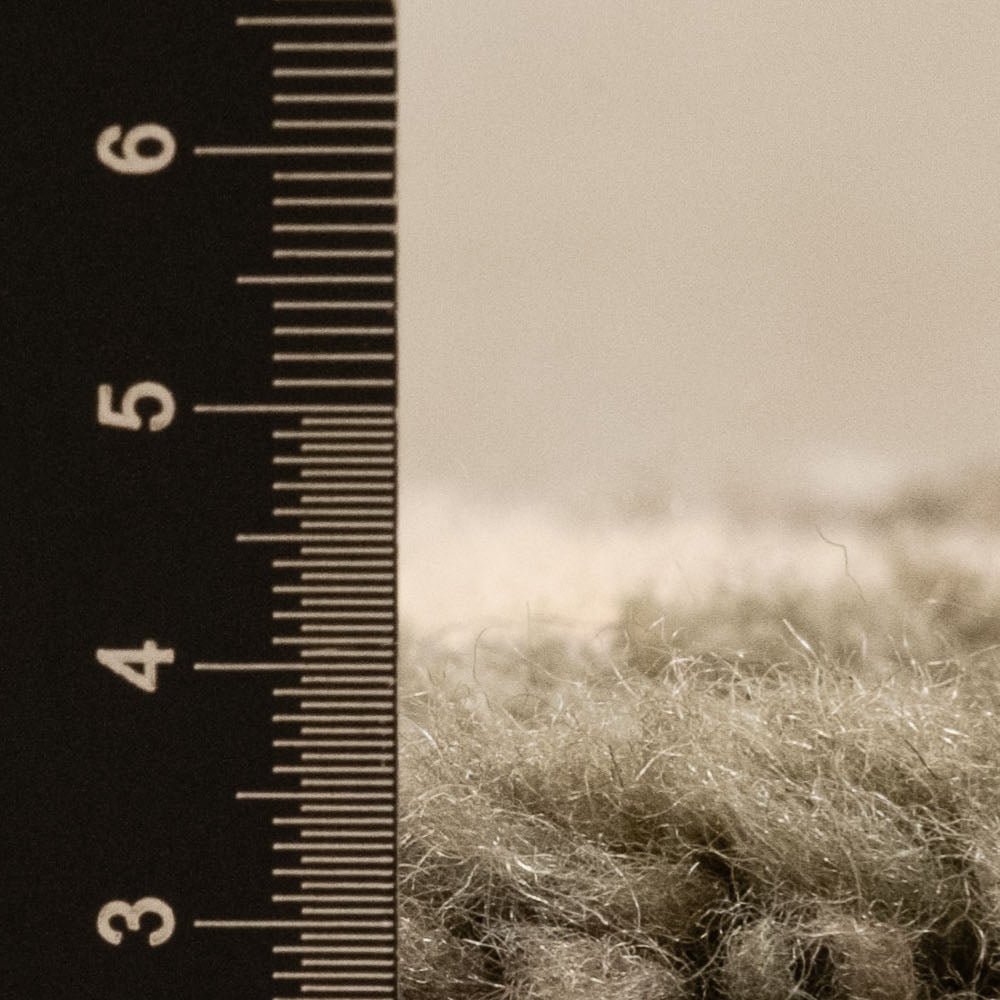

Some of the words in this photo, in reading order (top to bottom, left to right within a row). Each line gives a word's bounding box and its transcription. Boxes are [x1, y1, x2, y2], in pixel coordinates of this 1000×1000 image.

[96, 123, 176, 174] 6
[97, 381, 176, 432] 5
[96, 639, 175, 693] 4
[96, 896, 176, 947] 3
